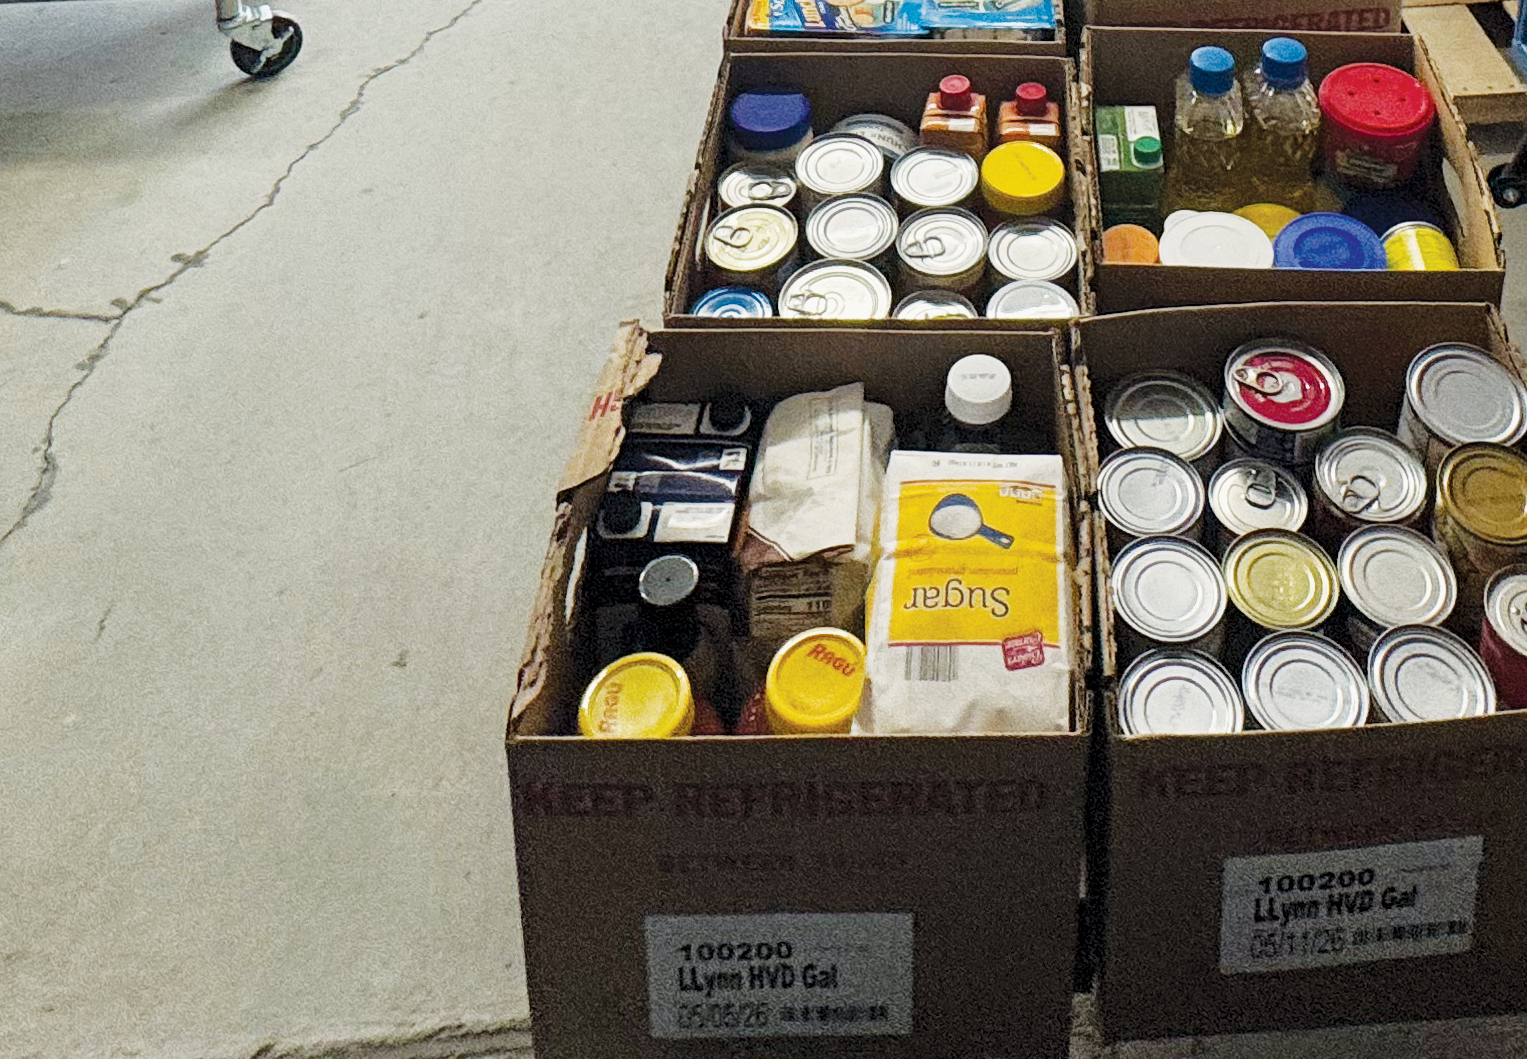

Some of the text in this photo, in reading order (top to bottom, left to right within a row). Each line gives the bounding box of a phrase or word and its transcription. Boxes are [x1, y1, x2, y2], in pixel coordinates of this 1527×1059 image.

[903, 578, 1011, 618] Sugar
[523, 778, 1048, 818] KEEP REFRIGERATED
[1258, 868, 1376, 895] 100200
[1253, 886, 1418, 926] LLynn HVD Gal
[677, 941, 793, 961] 100200
[678, 963, 839, 996] LLynn HVD Gal
